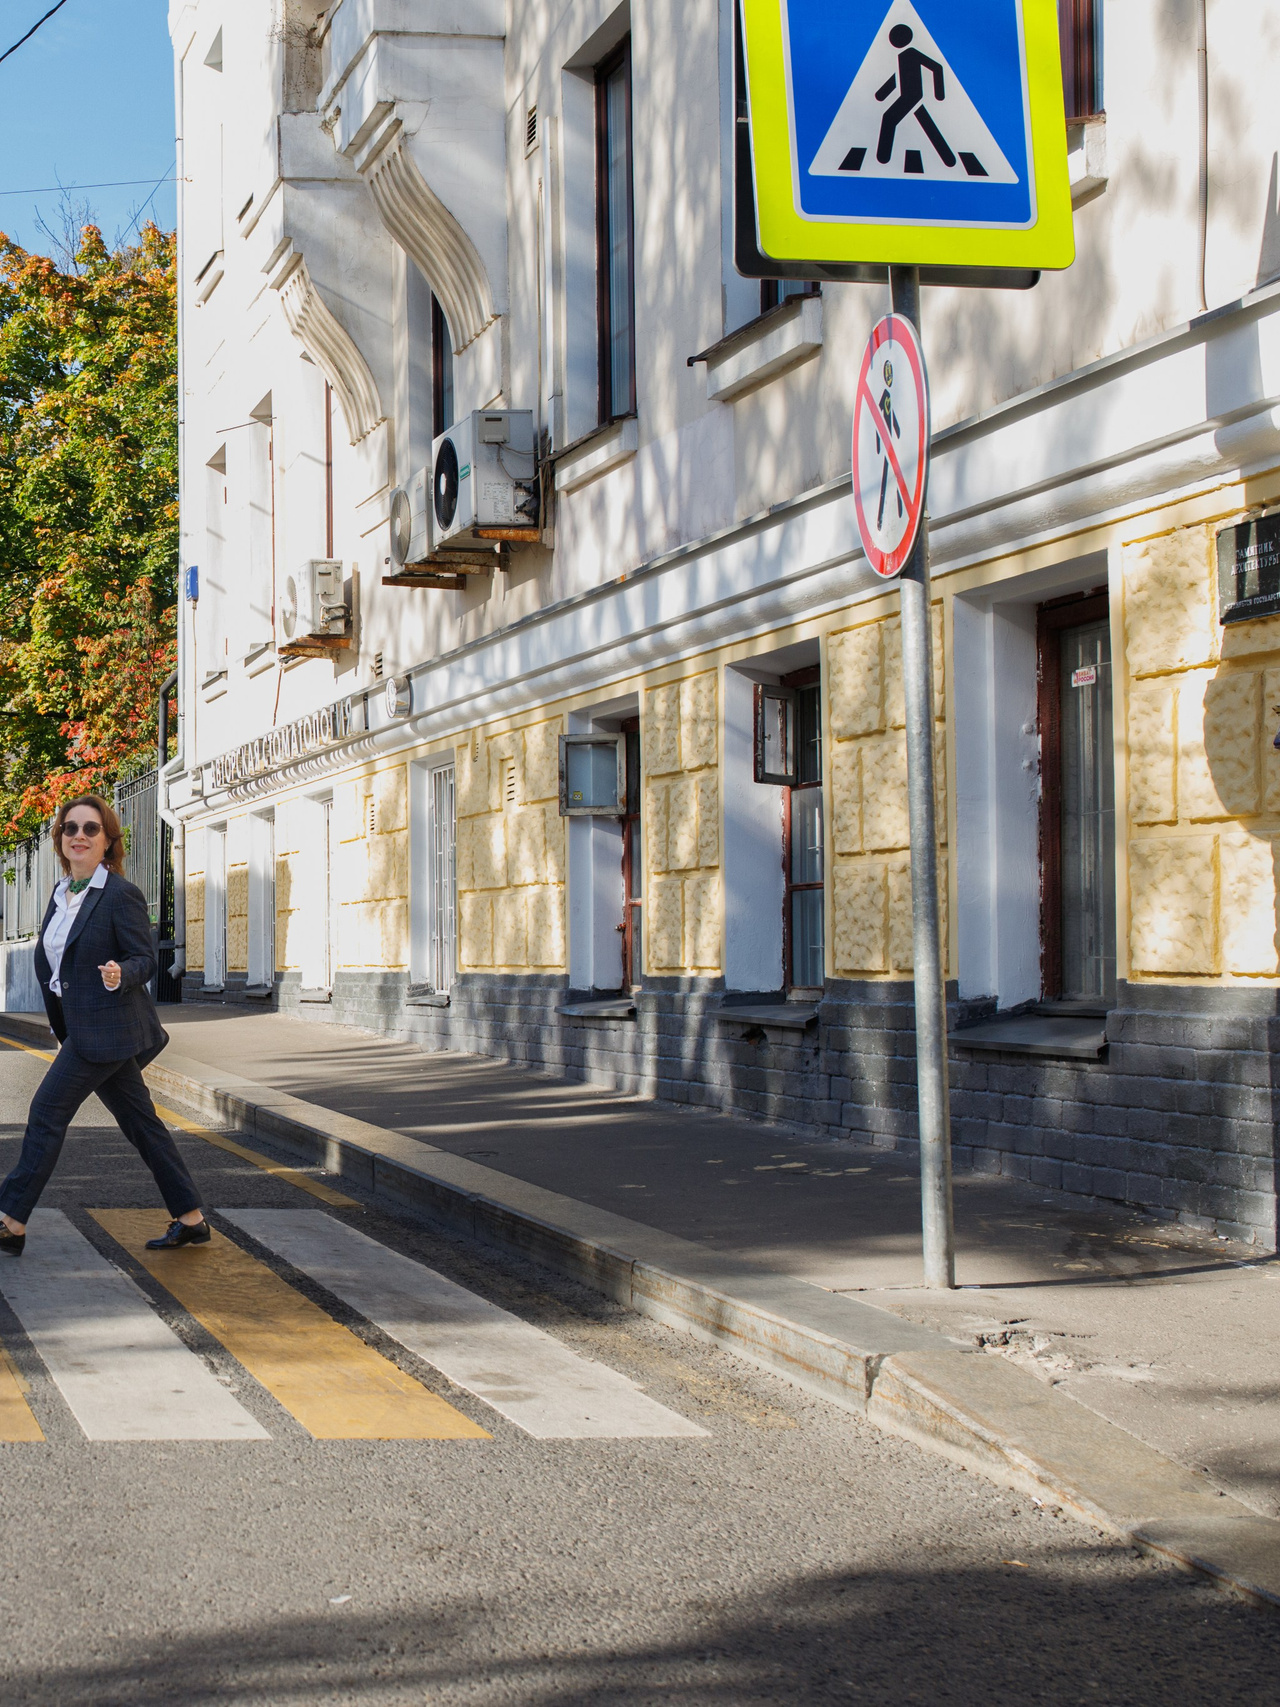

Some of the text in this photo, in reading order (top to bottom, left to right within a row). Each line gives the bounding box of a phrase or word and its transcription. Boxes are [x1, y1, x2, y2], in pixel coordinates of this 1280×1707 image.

[1230, 553, 1280, 576] АРХИТЕКТУРЫ
[1253, 592, 1280, 605] ГОСУДАРСТ
[211, 696, 352, 788] АВТОРСКАЯ СТОМАТОЛОГИЯ
